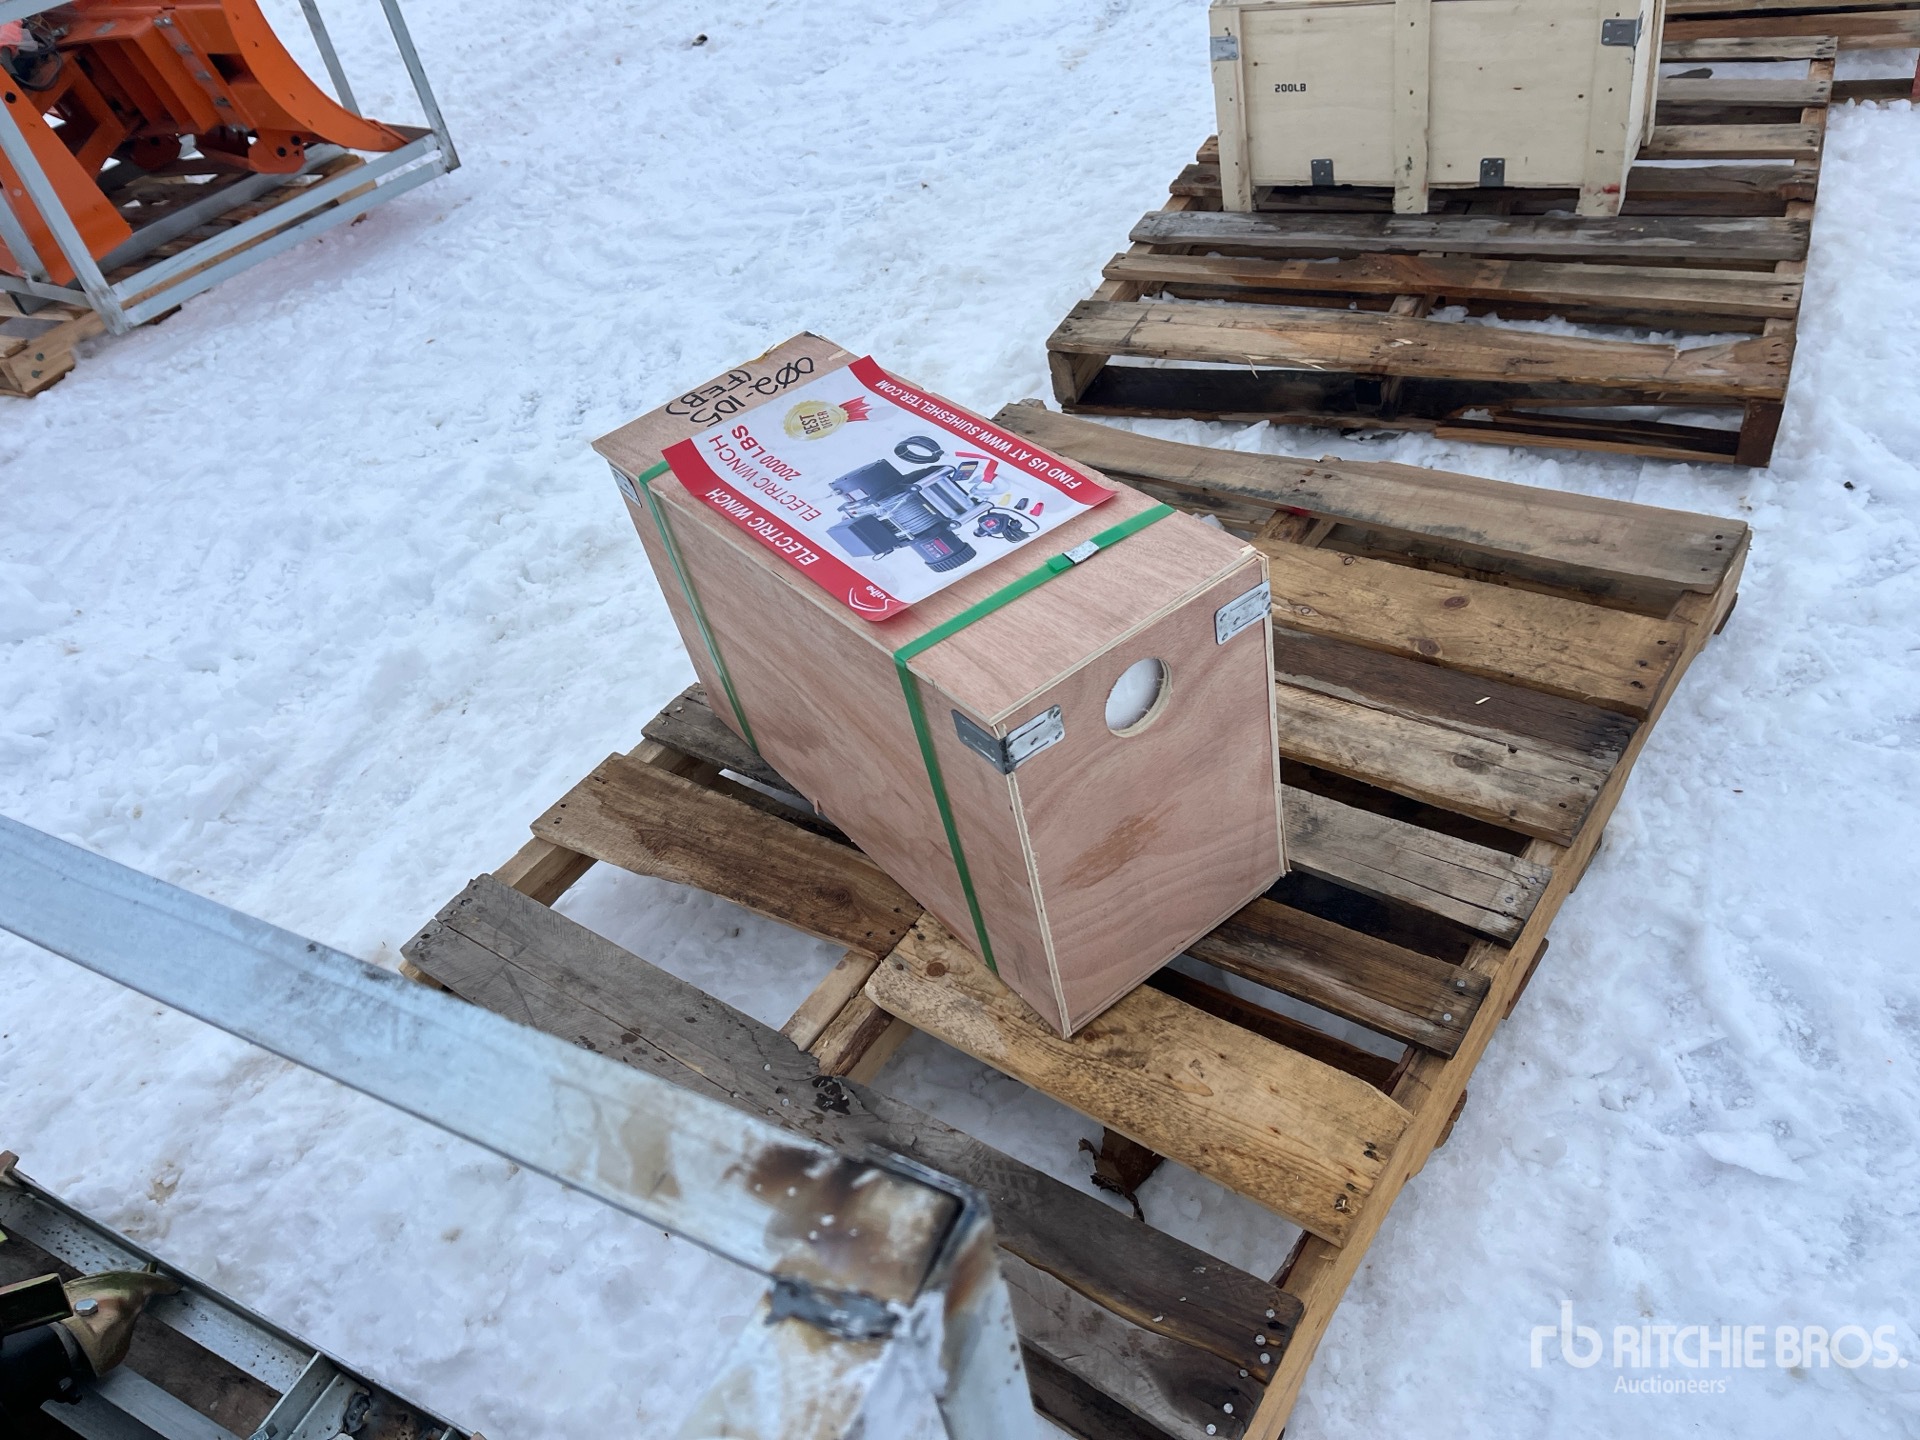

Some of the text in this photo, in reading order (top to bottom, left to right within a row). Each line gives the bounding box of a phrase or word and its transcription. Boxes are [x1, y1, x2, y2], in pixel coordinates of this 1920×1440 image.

[1274, 83, 1307, 93] 200LB
[665, 369, 752, 415] (FEB)
[798, 414, 822, 435] BEST
[817, 410, 834, 430] OFFER
[875, 379, 1083, 490] FIND US AT WWW.SUIHESHELTER.COM
[708, 434, 822, 522] ELECTRIC WINCH
[731, 424, 802, 482] 20000 LBS
[704, 487, 820, 566] ELECTRIC WINCH
